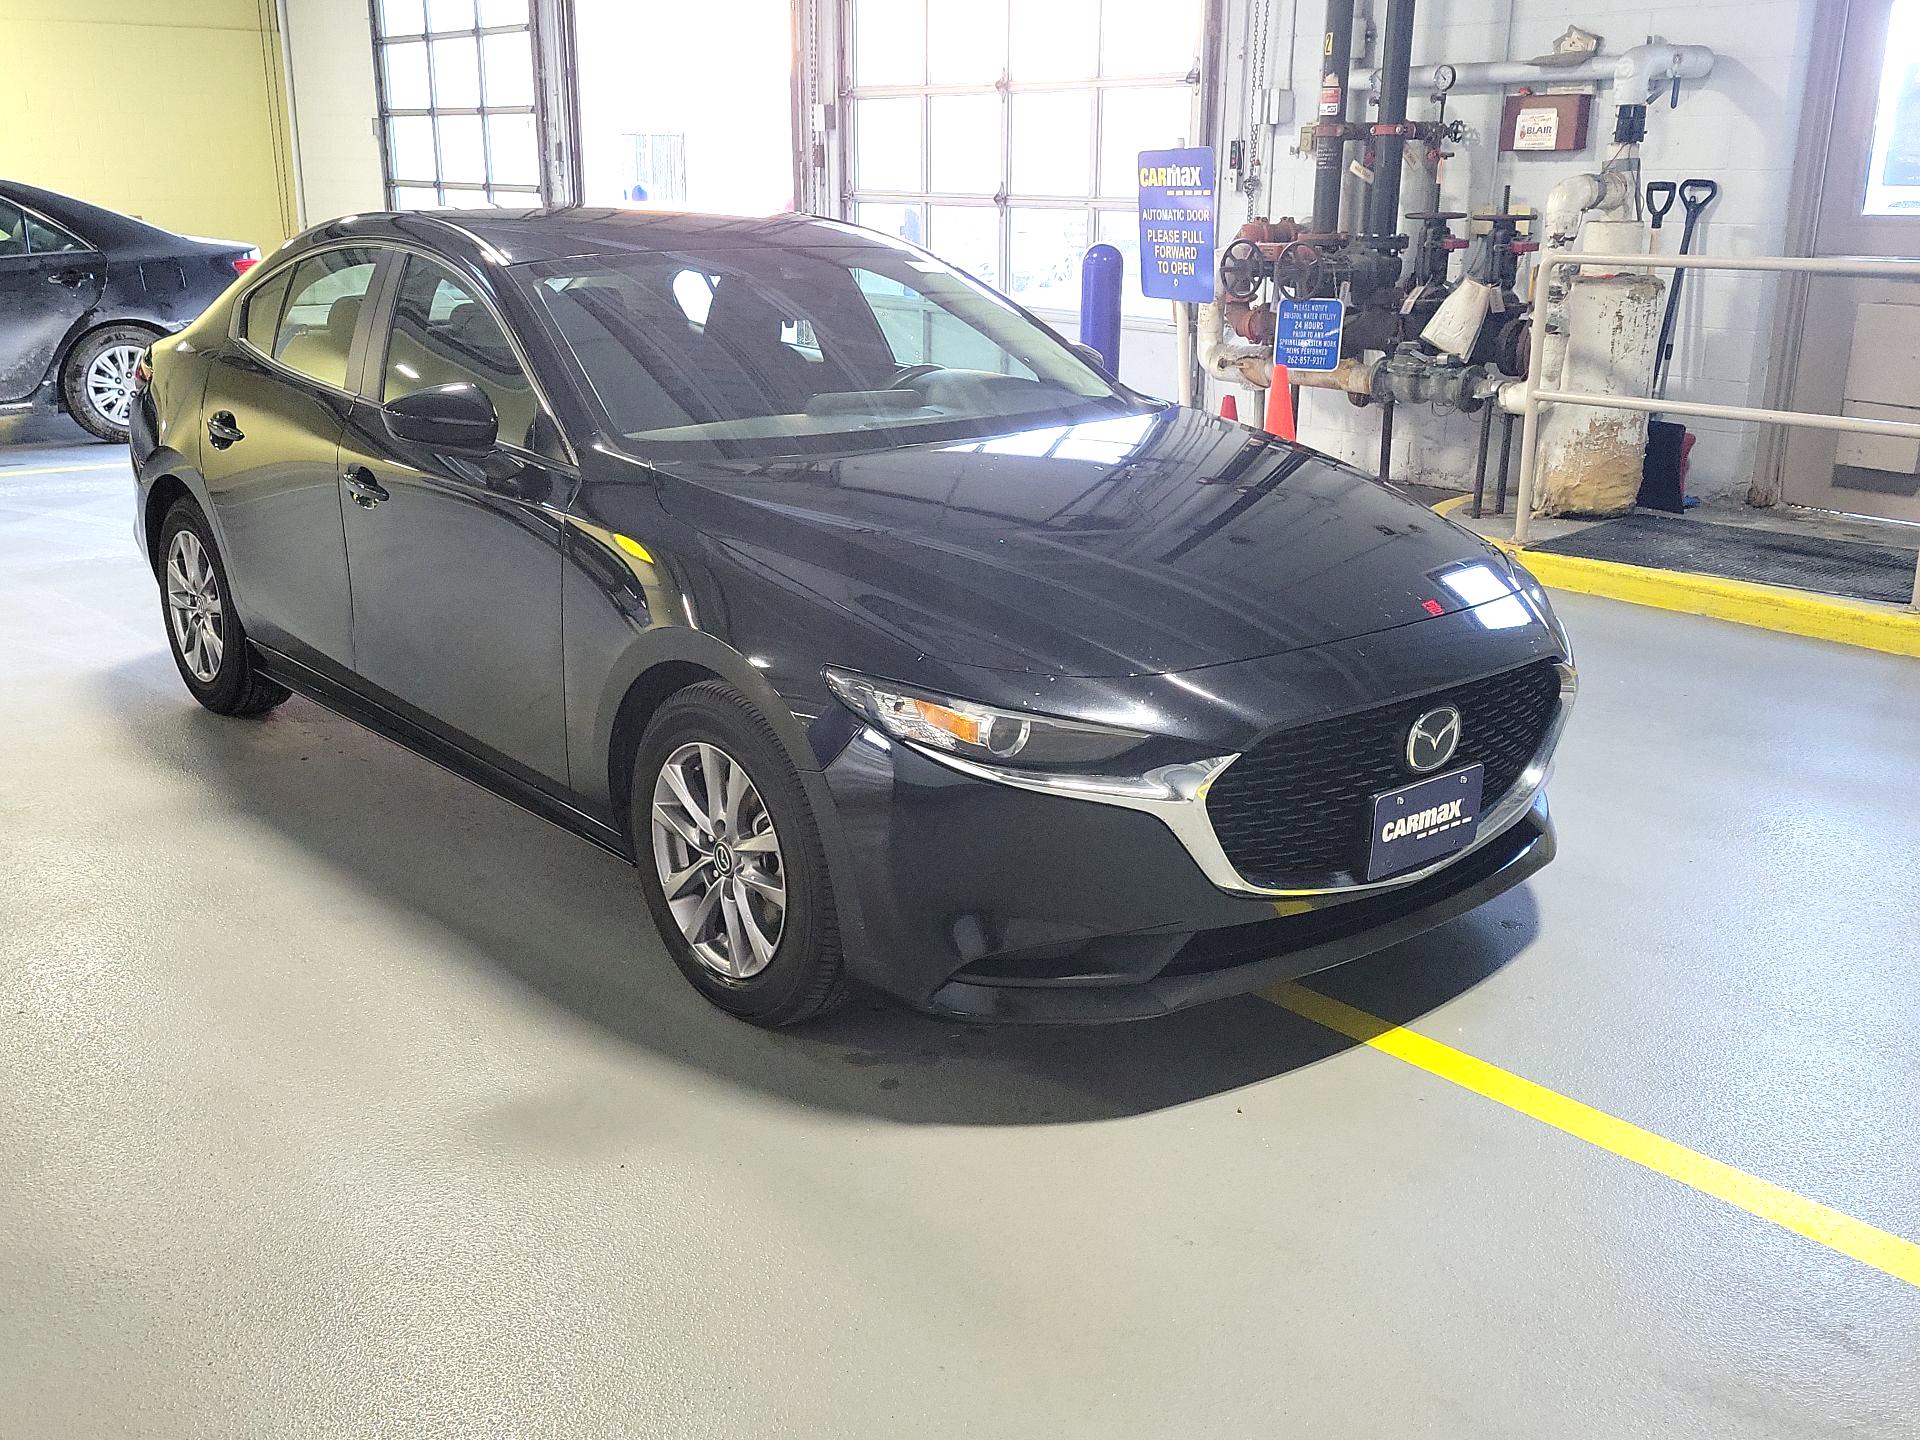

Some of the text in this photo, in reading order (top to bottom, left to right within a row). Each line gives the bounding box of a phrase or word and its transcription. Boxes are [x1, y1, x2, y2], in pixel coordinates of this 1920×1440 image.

[1526, 126, 1552, 135] BLAIR
[1142, 208, 1210, 221] AUTOMATIC DOOR
[1147, 229, 1205, 244] PLEASE PULL
[1154, 245, 1197, 260] FORWARD
[1157, 261, 1195, 276] TO OPEN
[1311, 304, 1328, 312] NOTIFY
[1303, 312, 1319, 320] WATER
[1294, 321, 1324, 330] 24 HOURS
[1292, 330, 1306, 338] PRIOR
[1313, 331, 1324, 339] ANY
[1323, 340, 1337, 348] WORK
[1300, 348, 1328, 356] PERFORMED
[1287, 356, 1326, 365] 262-857-9371
